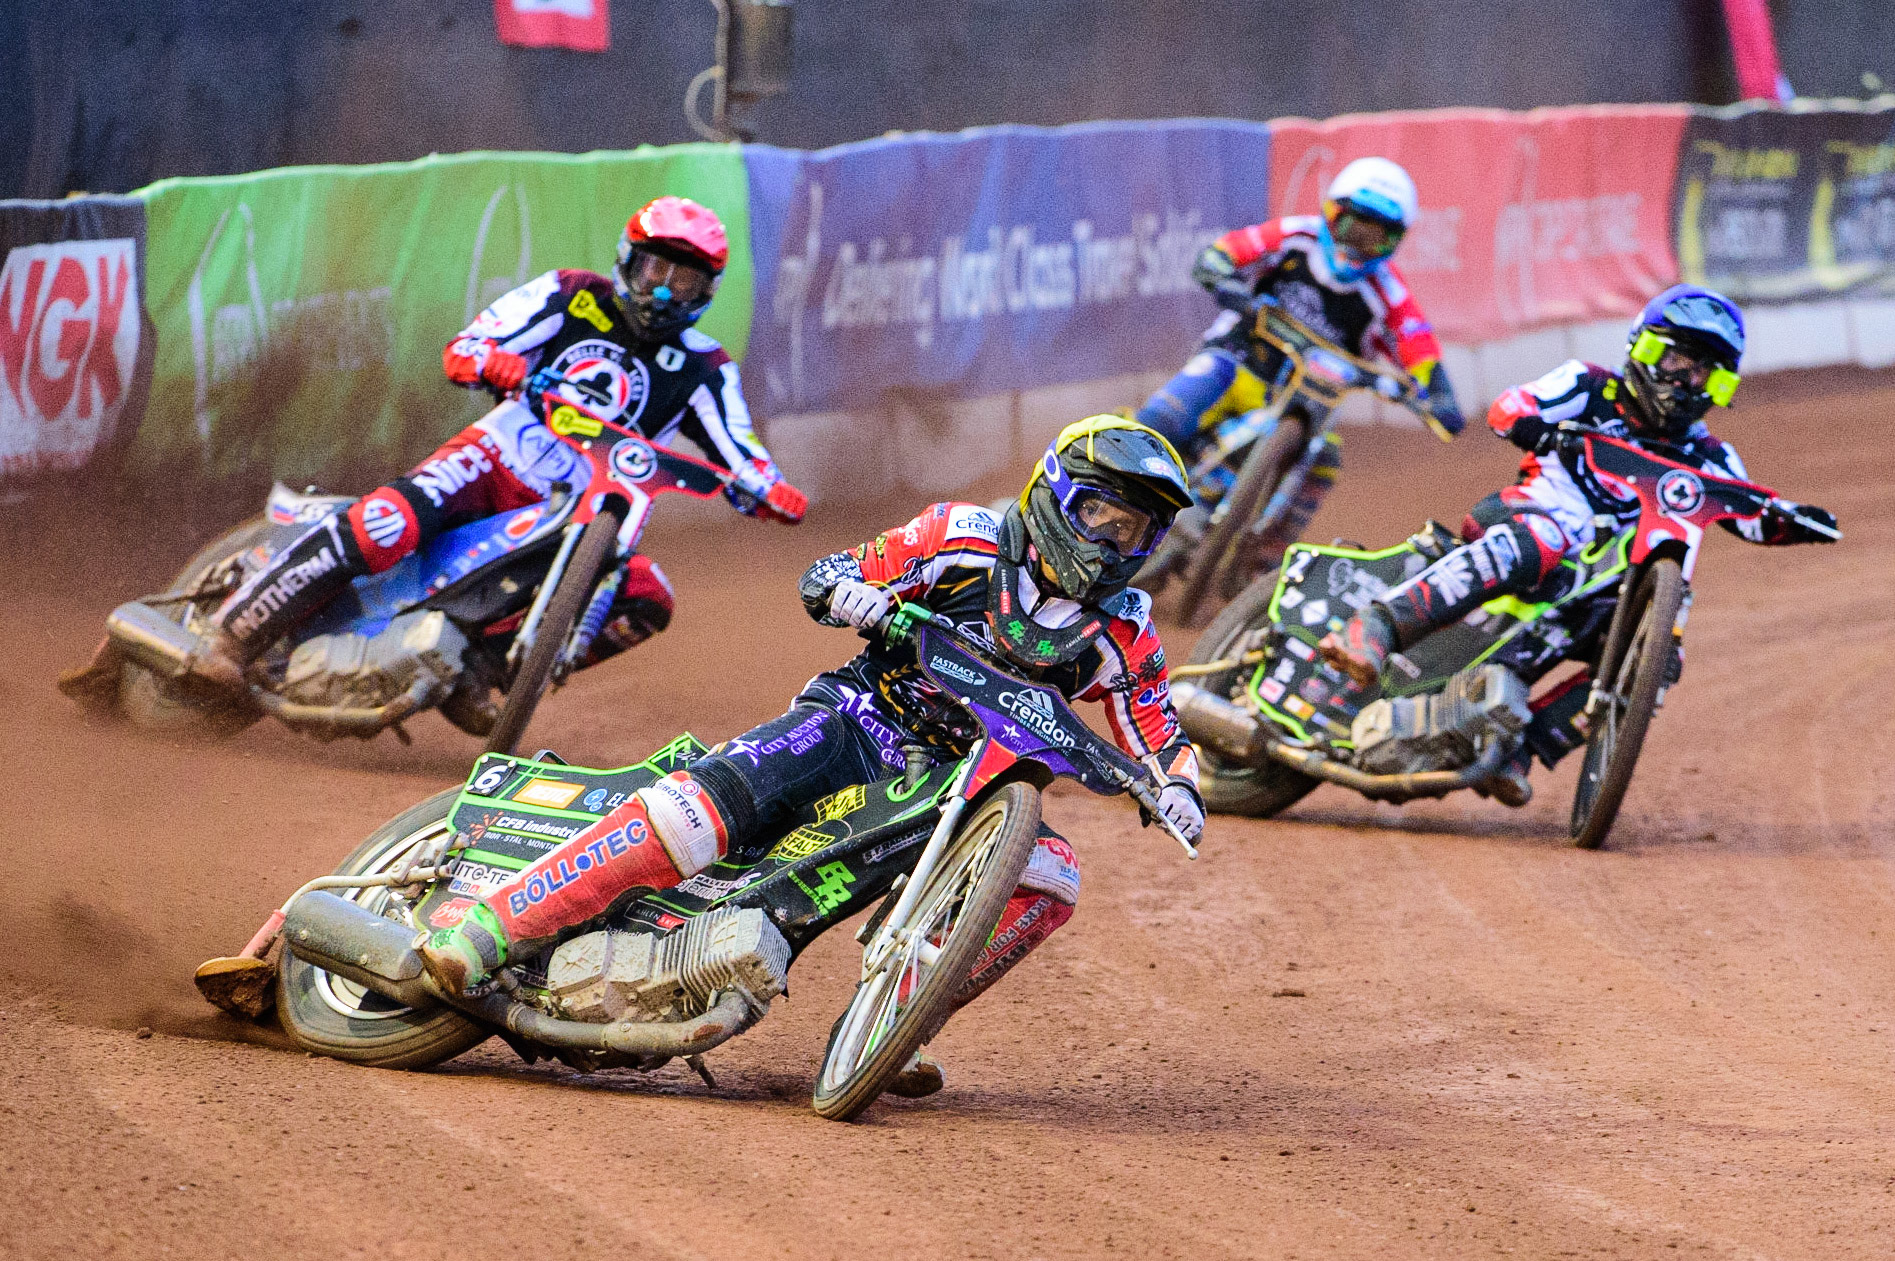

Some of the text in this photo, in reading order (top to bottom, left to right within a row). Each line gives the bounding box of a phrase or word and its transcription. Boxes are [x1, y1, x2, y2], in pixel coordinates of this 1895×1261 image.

[1005, 223, 1074, 310] Class
[932, 655, 977, 679] FASTRACK
[761, 711, 831, 755] CITY AUCTION
[859, 714, 900, 745] CITY
[997, 691, 1076, 748] Crendon
[790, 728, 825, 756] GROUP
[474, 764, 509, 790] 6
[496, 816, 527, 830] CFB
